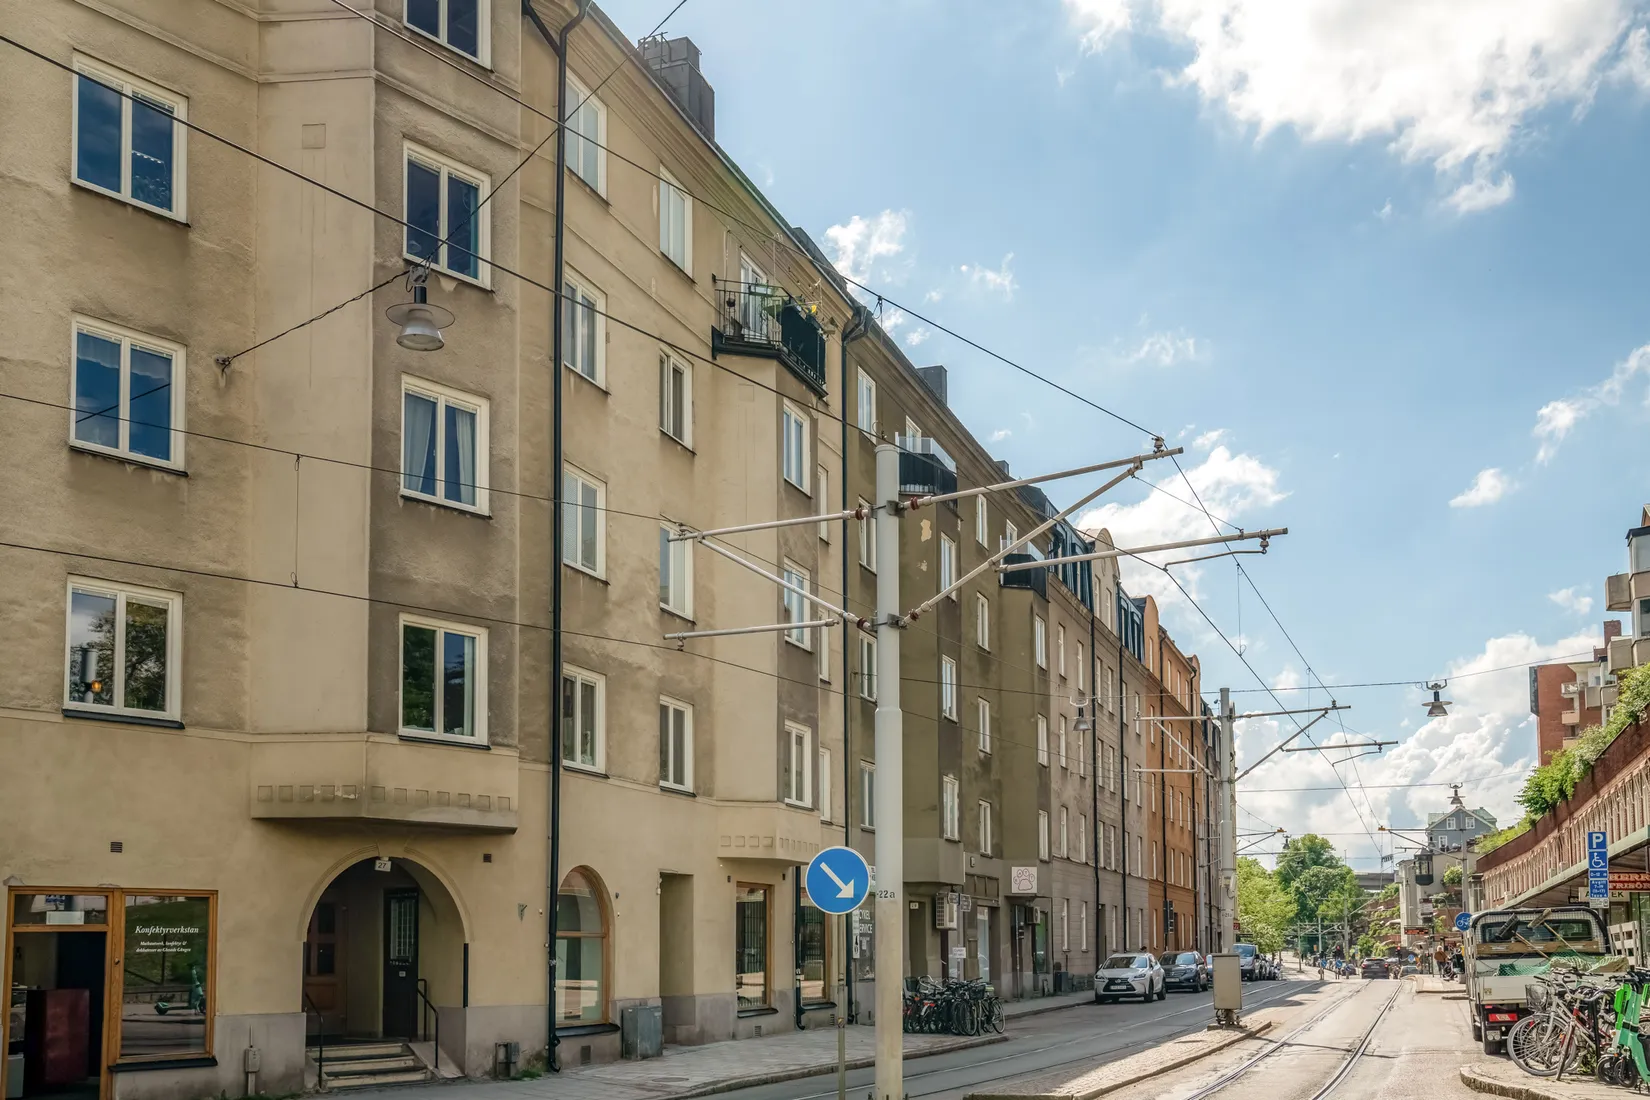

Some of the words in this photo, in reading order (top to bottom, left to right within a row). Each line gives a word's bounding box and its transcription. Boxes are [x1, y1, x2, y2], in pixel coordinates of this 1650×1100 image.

[1592, 833, 1604, 848] P
[377, 861, 387, 869] 27
[134, 926, 199, 936] Konfektyrverkstan
[859, 923, 873, 934] ERVICE
